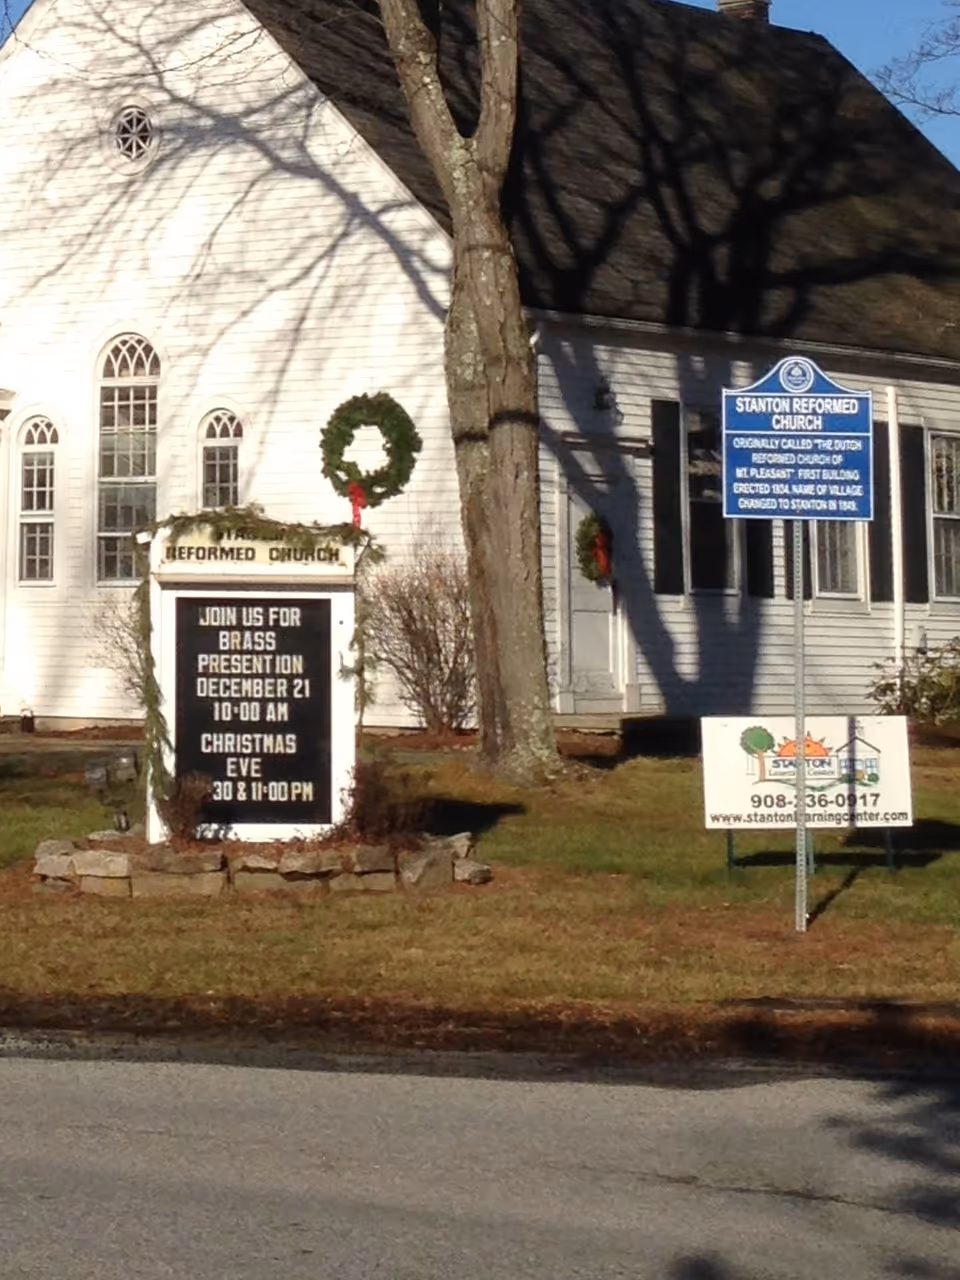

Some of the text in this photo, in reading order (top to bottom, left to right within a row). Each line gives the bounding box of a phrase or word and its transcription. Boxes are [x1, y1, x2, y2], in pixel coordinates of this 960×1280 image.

[736, 397, 859, 415] STANTON REFORMED
[772, 415, 823, 431] CHURCH
[733, 437, 780, 450] ORIGINALLY
[781, 438, 813, 450] CALLED
[833, 439, 863, 451] DUTCH
[752, 453, 843, 465] REFORMED CHURCH OF
[798, 468, 820, 480] FIRST
[822, 469, 860, 481] BUILDING
[733, 482, 771, 494] ERECTED
[791, 484, 816, 496] NAME
[816, 484, 828, 496] OF
[738, 497, 778, 510] CHANGED
[778, 498, 790, 510] TO
[790, 499, 828, 511] STANTON
[828, 499, 837, 511] IN
[165, 546, 340, 562] REFORMED CHURCH
[199, 607, 302, 627] JOIN US FOR
[219, 630, 276, 651] BRASS
[196, 677, 310, 699] DECEMBER 21
[213, 701, 289, 722] 10:00 AM
[201, 733, 297, 754] CHRISTMAS
[226, 757, 262, 778] EVE
[772, 758, 832, 769] STATON
[236, 781, 248, 802] &
[251, 781, 289, 802] 11:00
[291, 782, 313, 802] PM
[710, 810, 909, 824] www.stantonlarningcenter.com
